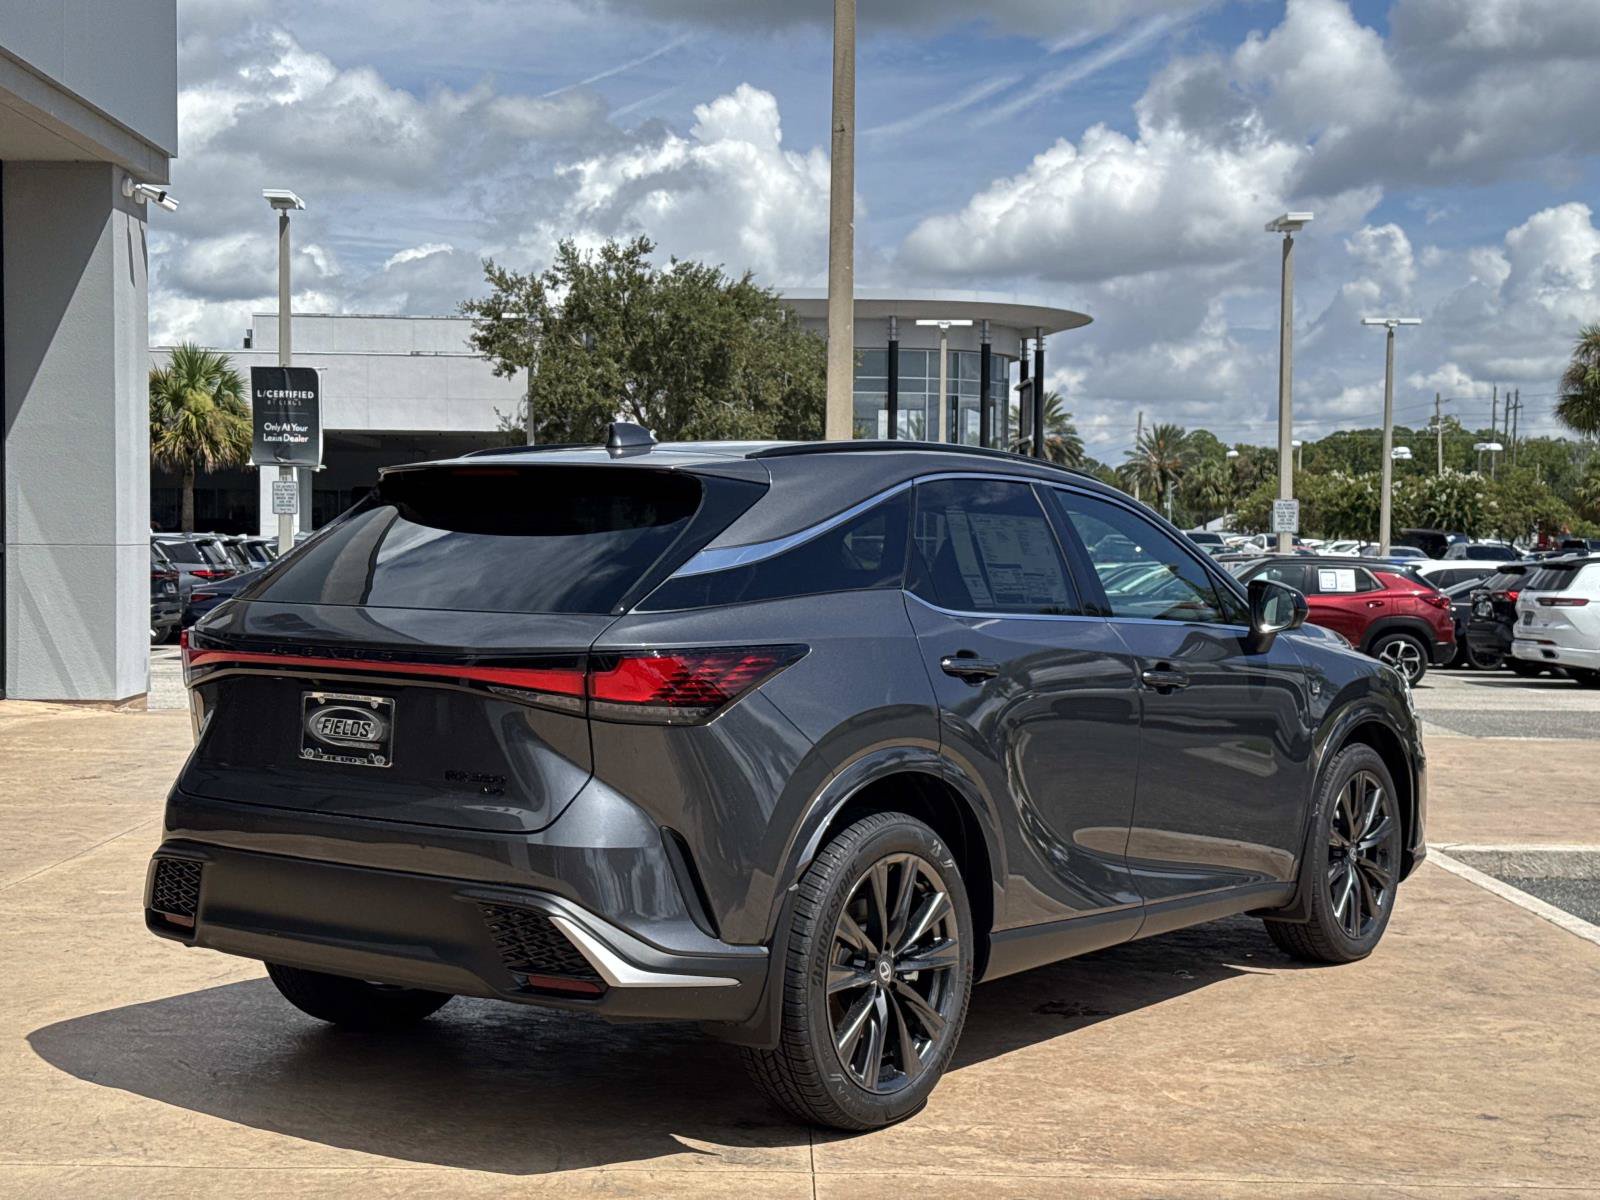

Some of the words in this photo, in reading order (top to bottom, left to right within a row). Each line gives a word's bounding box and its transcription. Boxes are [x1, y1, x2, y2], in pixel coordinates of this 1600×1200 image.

[257, 389, 315, 399] L/CERTIFIED
[263, 422, 281, 432] Only
[281, 423, 291, 432] At
[291, 423, 309, 433] Your
[263, 433, 282, 442] Lexus
[283, 433, 310, 443] Dealer
